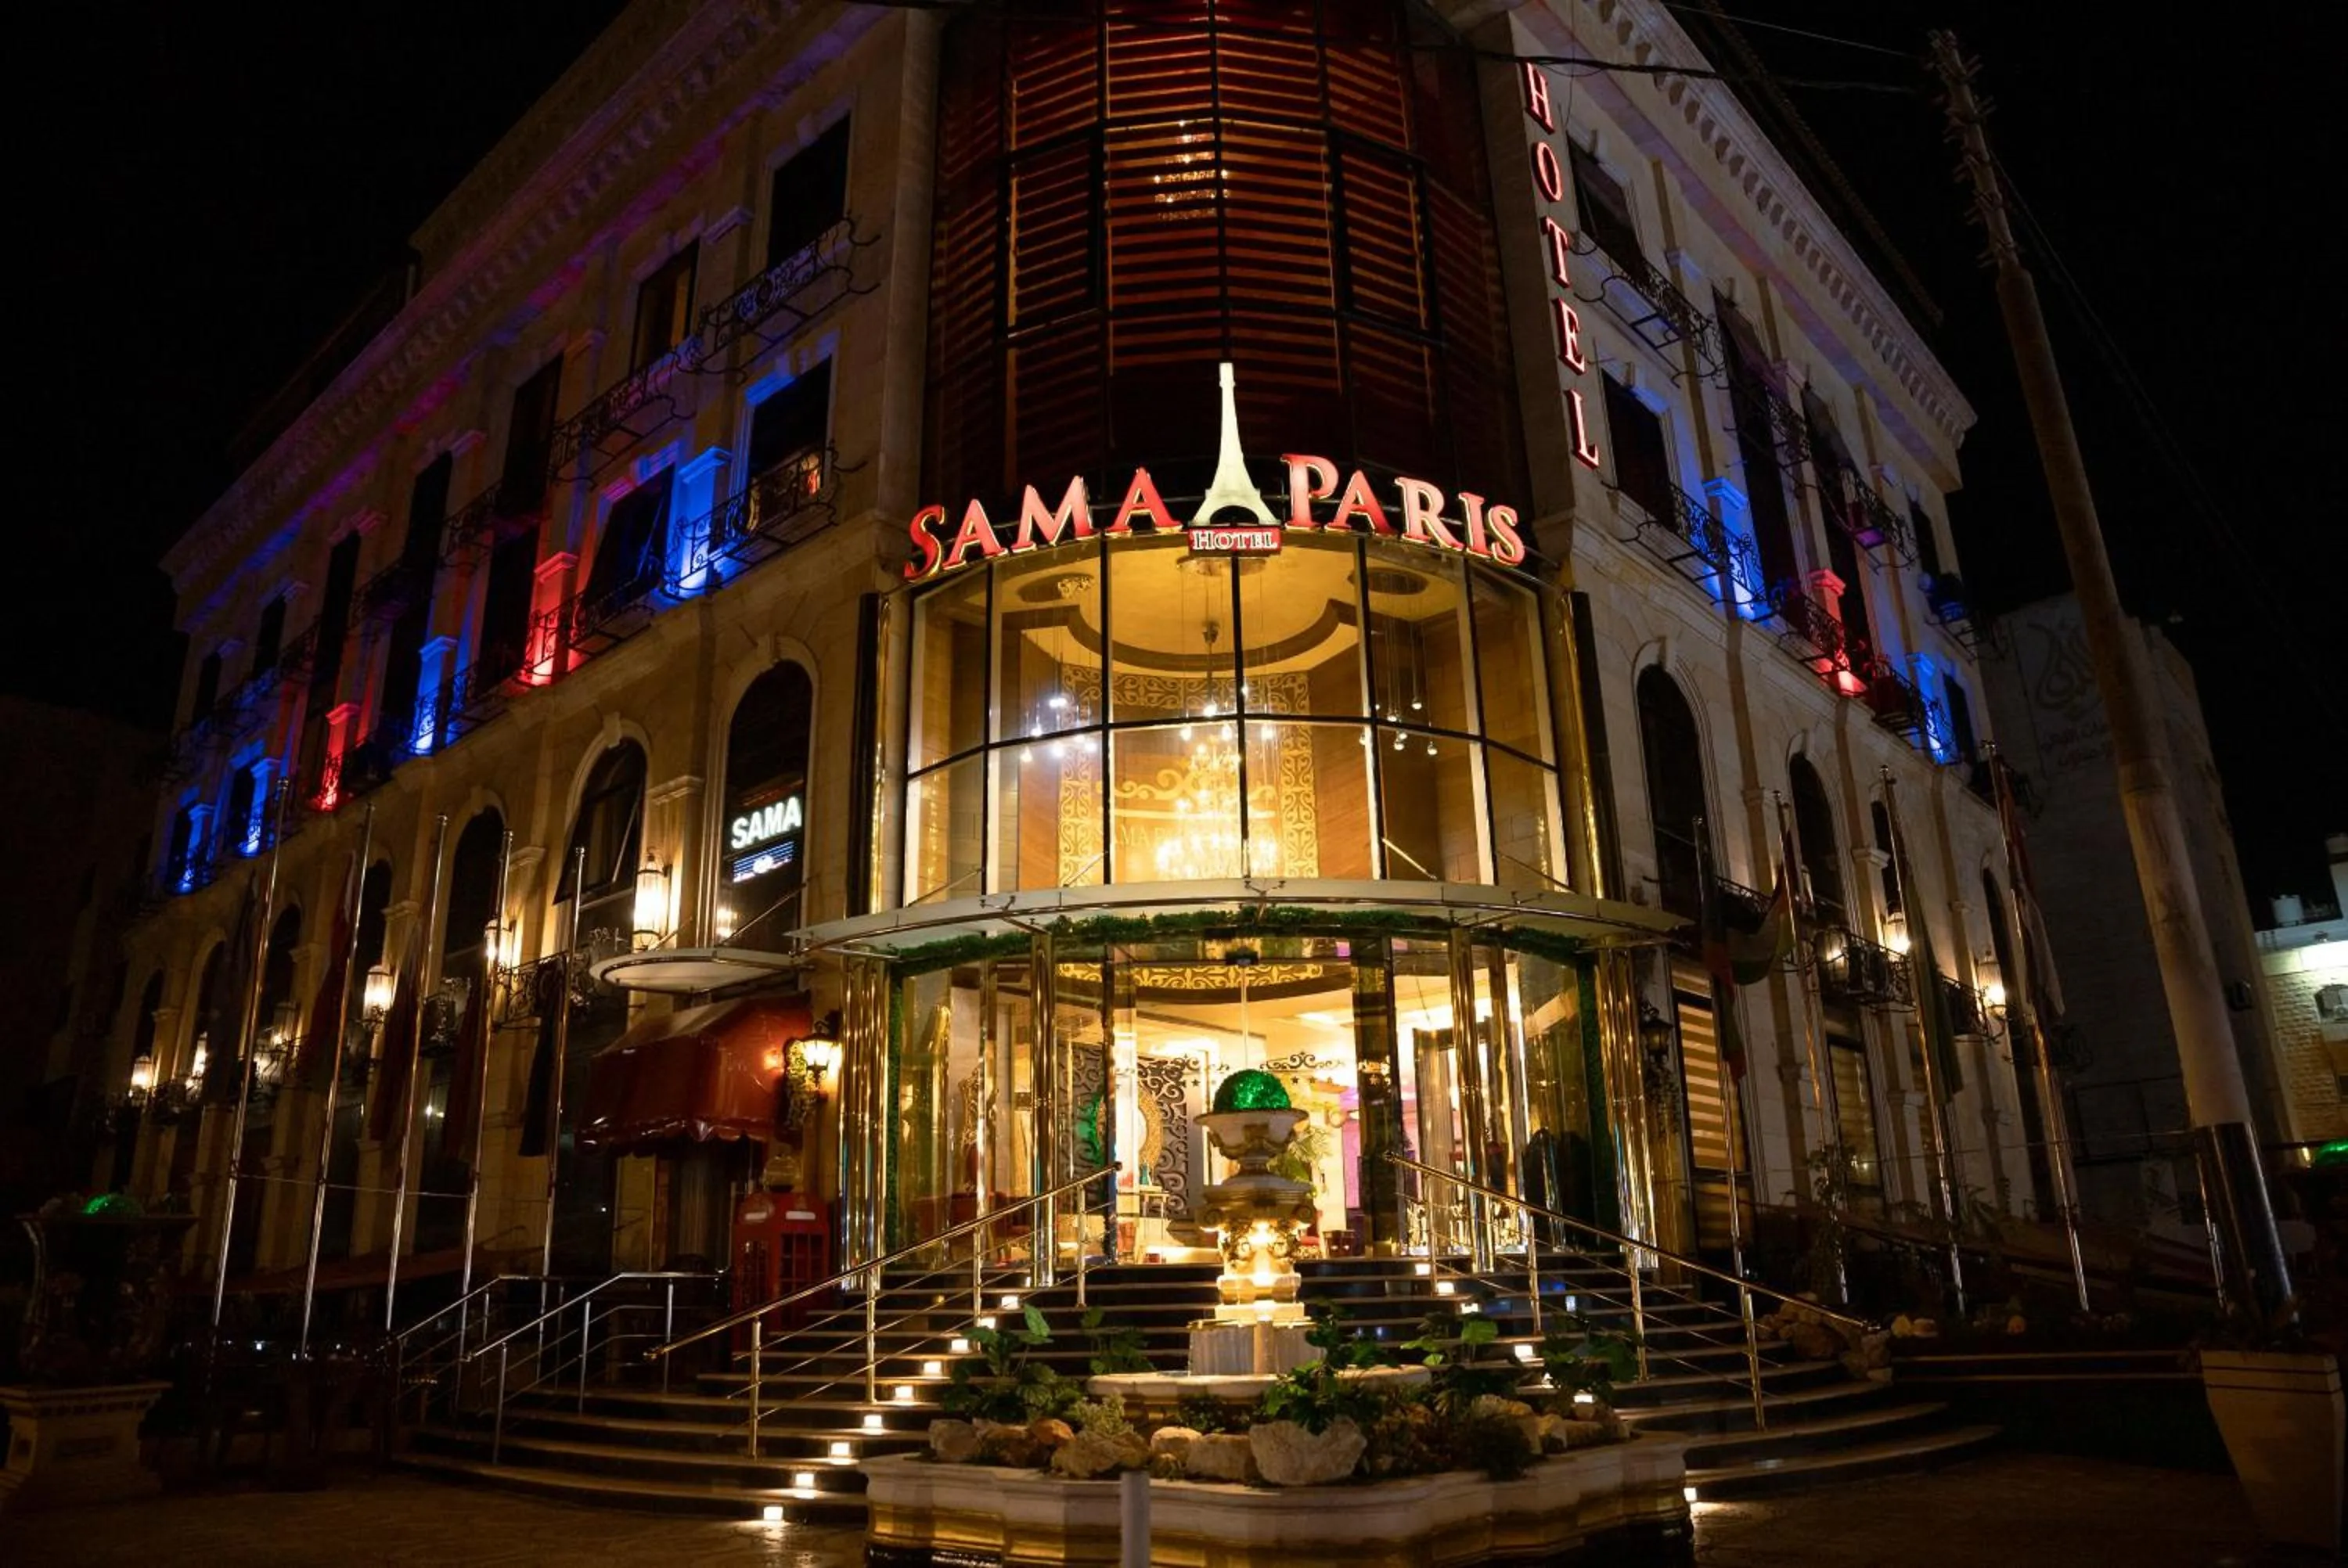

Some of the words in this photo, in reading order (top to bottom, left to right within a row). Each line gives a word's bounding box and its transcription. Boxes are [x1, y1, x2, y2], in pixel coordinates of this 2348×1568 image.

[1525, 61, 1600, 469] HOTEL
[904, 466, 1183, 578] SAMA
[1281, 453, 1526, 566] PARIS
[1194, 530, 1277, 553] HOTEL
[731, 797, 802, 849] SAMA
